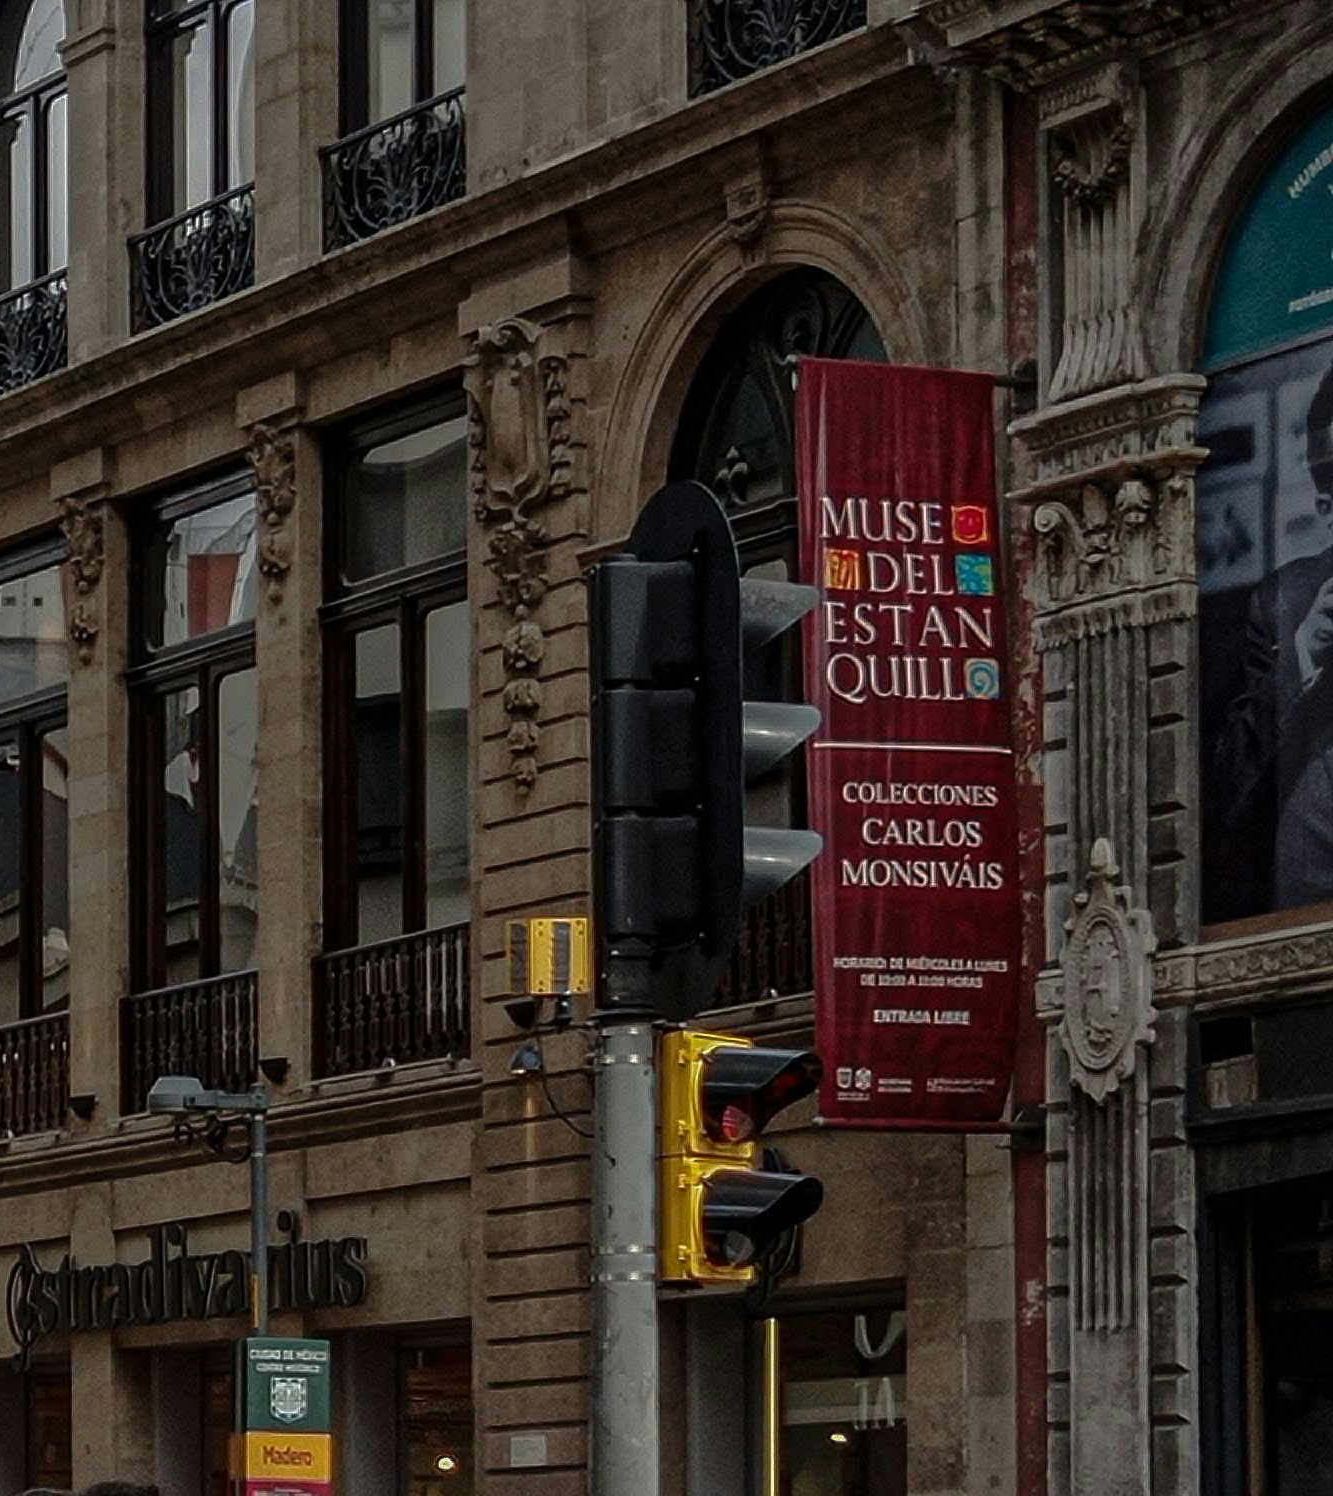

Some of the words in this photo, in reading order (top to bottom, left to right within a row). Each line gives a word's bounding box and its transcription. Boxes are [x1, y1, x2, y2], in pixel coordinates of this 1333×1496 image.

[867, 551, 954, 595] DEL
[823, 601, 994, 650] ESTAN
[842, 782, 1000, 807] COLECCIONES
[861, 817, 983, 848] CARLOS
[841, 853, 1004, 890] MONSIVÁIS
